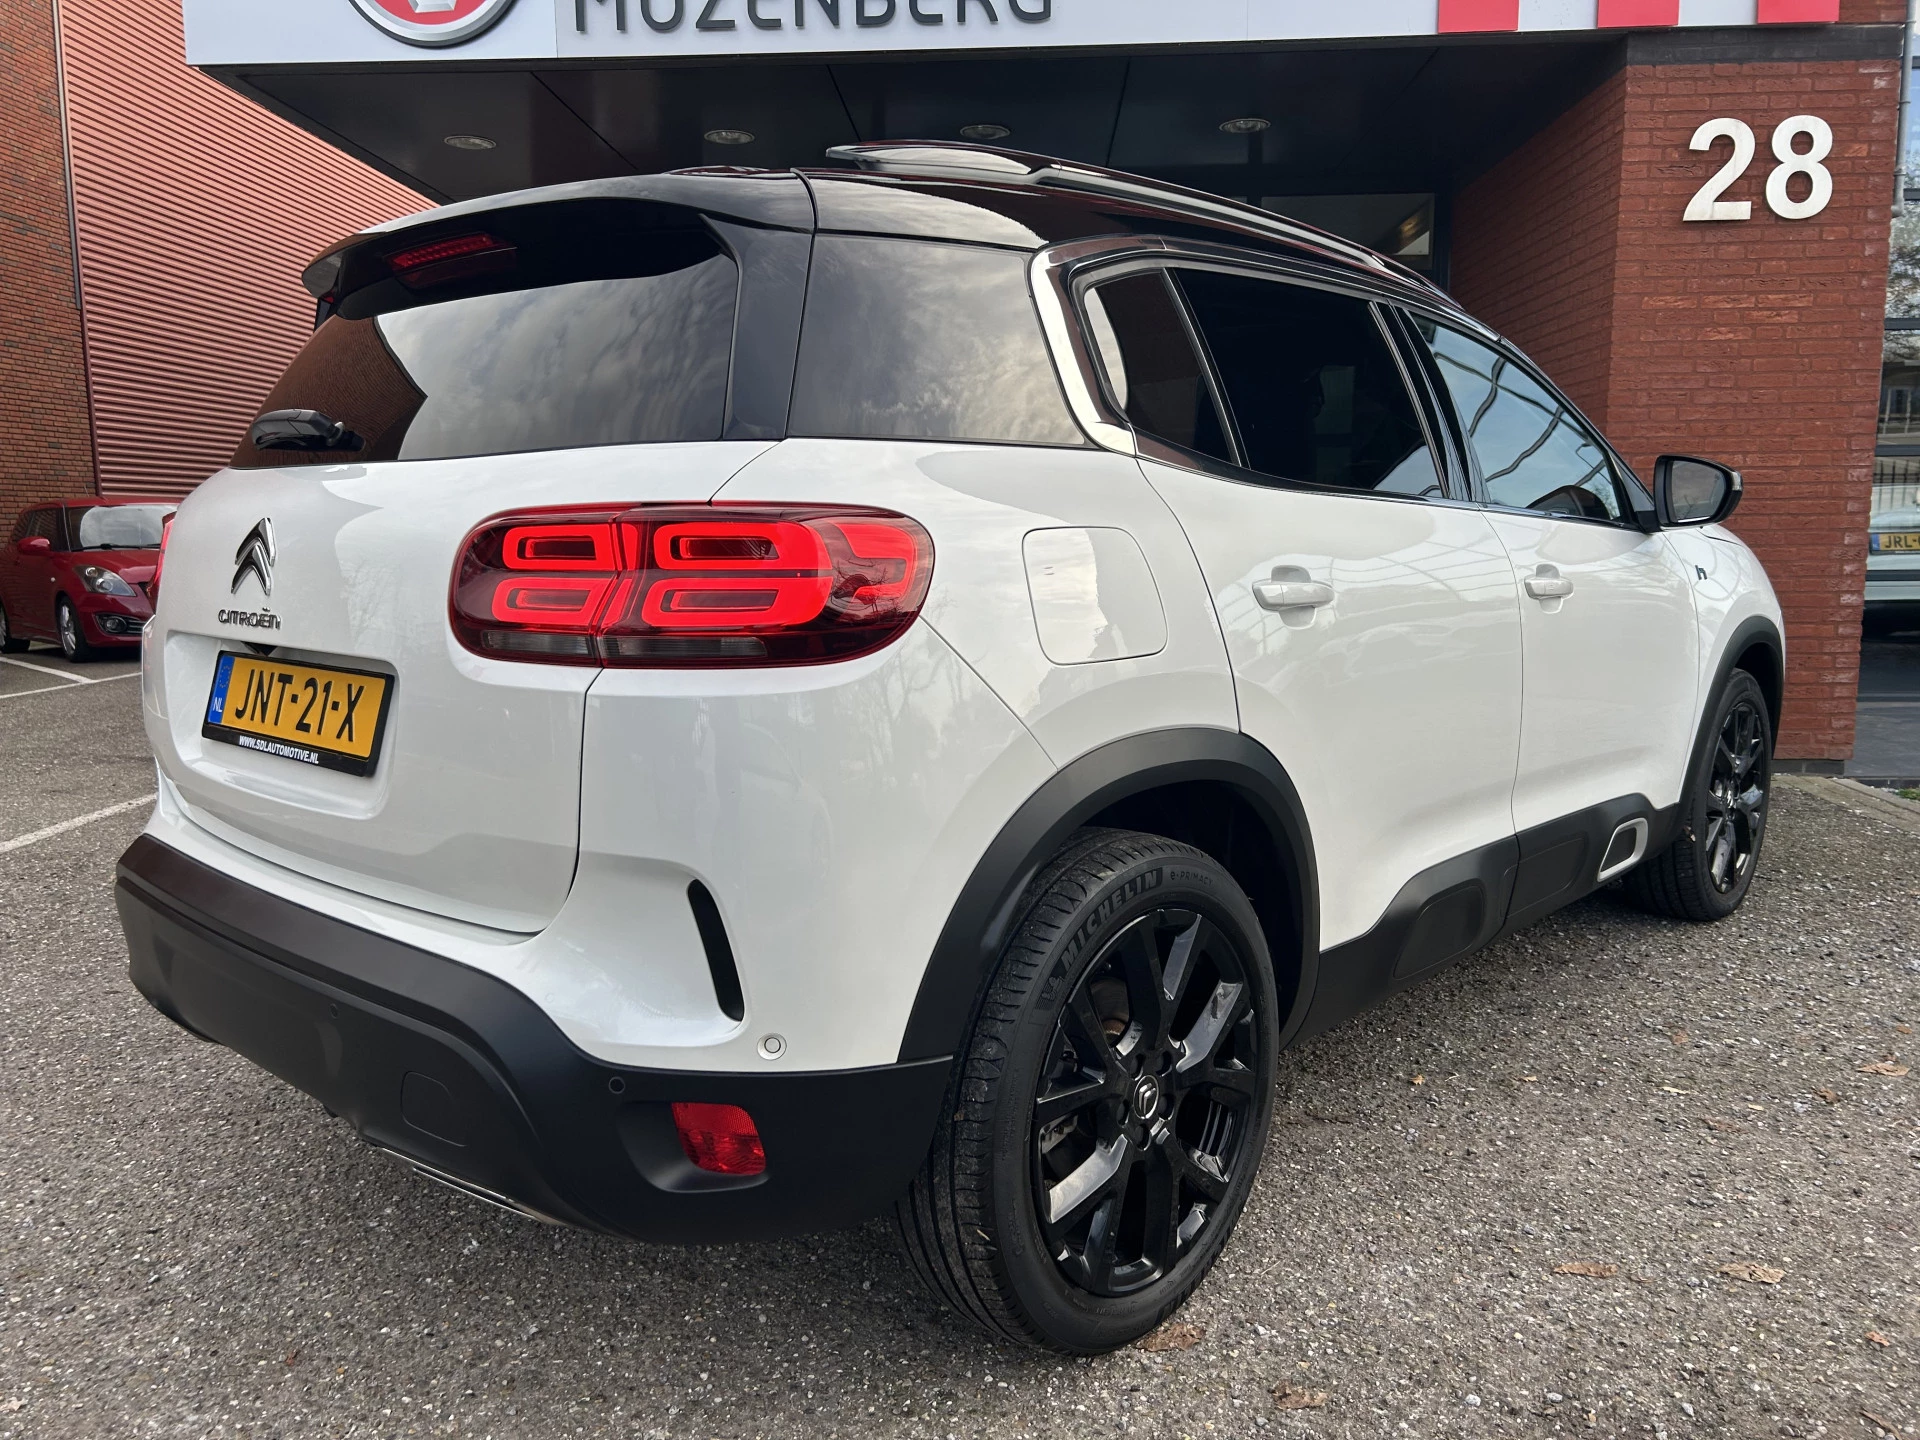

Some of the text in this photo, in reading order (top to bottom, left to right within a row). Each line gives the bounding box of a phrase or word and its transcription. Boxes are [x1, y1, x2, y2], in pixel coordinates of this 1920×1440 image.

[1683, 115, 1833, 221] 28
[1885, 535, 1920, 548] JRL-
[213, 697, 222, 712] NL
[235, 669, 364, 742] JNT-21-X
[239, 735, 319, 764] WWW.SDLAUTOMOTIVE.NL
[1060, 868, 1160, 972] MICHELIN
